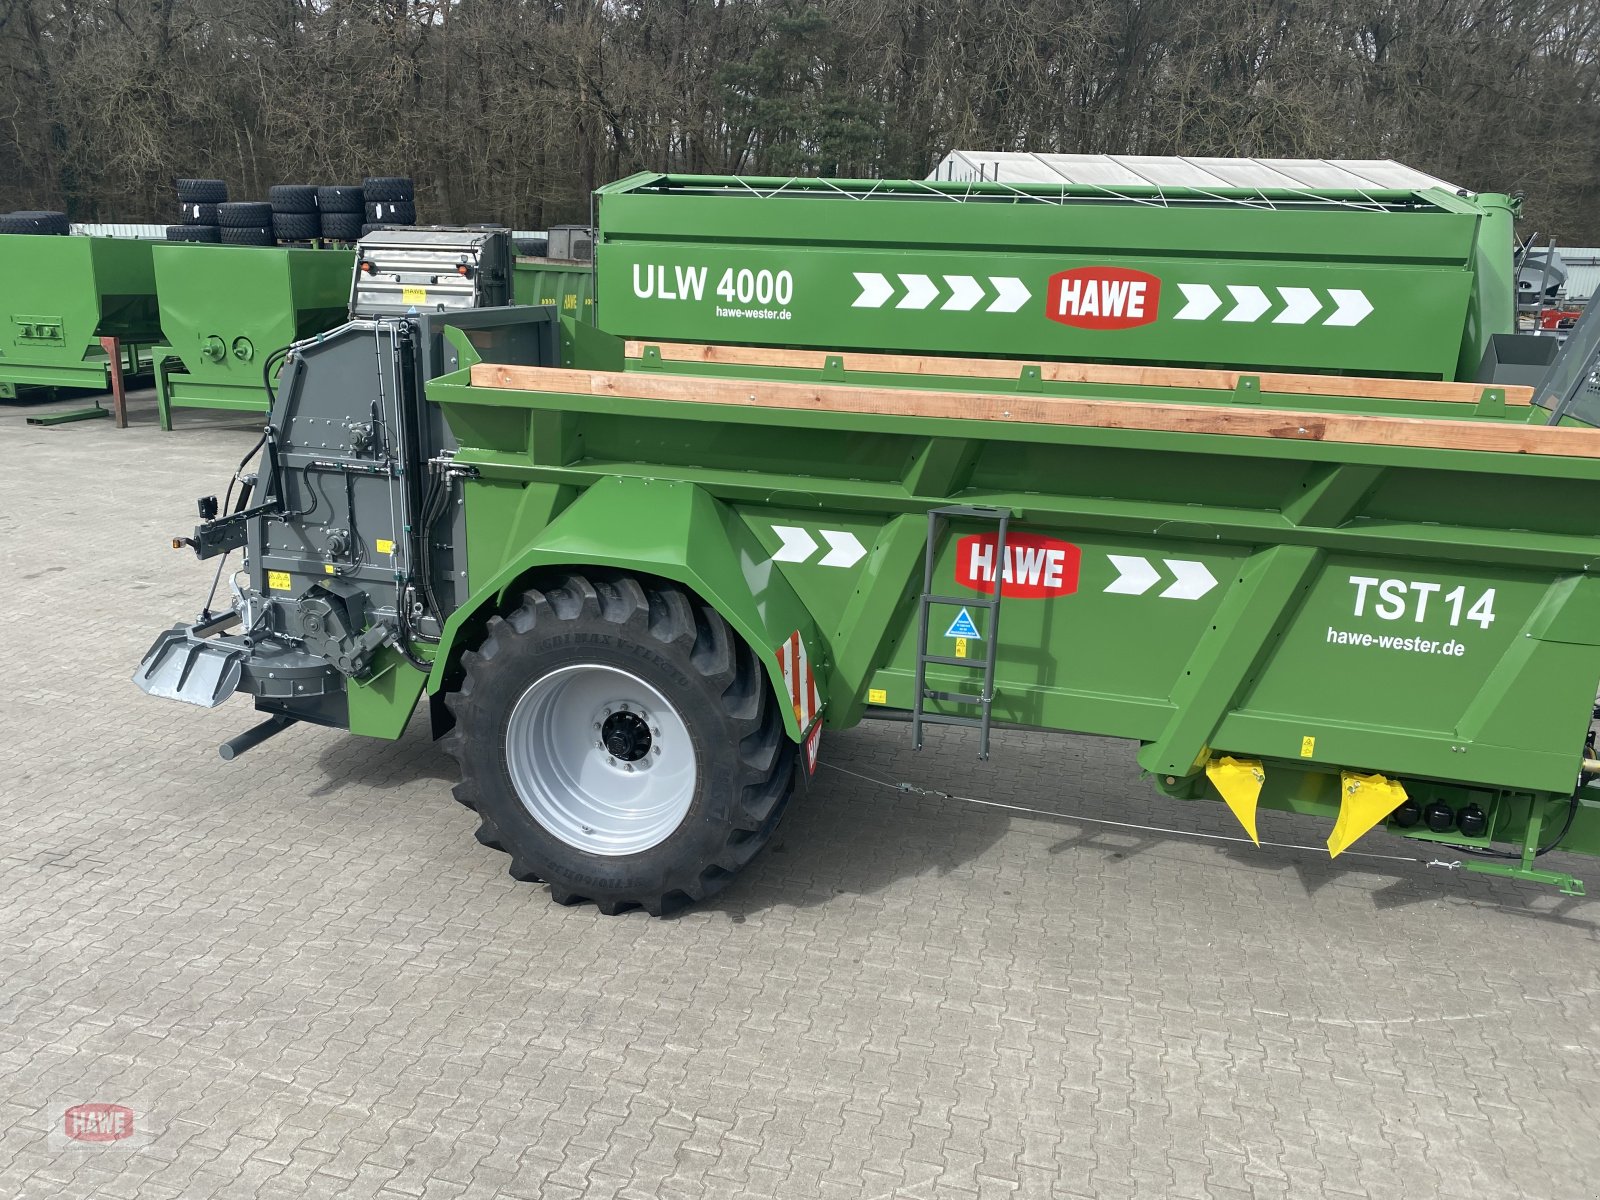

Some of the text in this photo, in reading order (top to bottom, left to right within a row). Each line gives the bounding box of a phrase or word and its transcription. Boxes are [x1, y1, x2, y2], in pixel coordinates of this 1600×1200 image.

[404, 287, 424, 295] HAWE
[633, 263, 793, 305] ULW 4000
[1059, 279, 1147, 318] HAWE
[716, 306, 792, 320] hawe-wester.de
[969, 542, 1065, 588] HAWE
[1349, 575, 1496, 629] TST 14
[1326, 626, 1465, 657] hawe-wester.de
